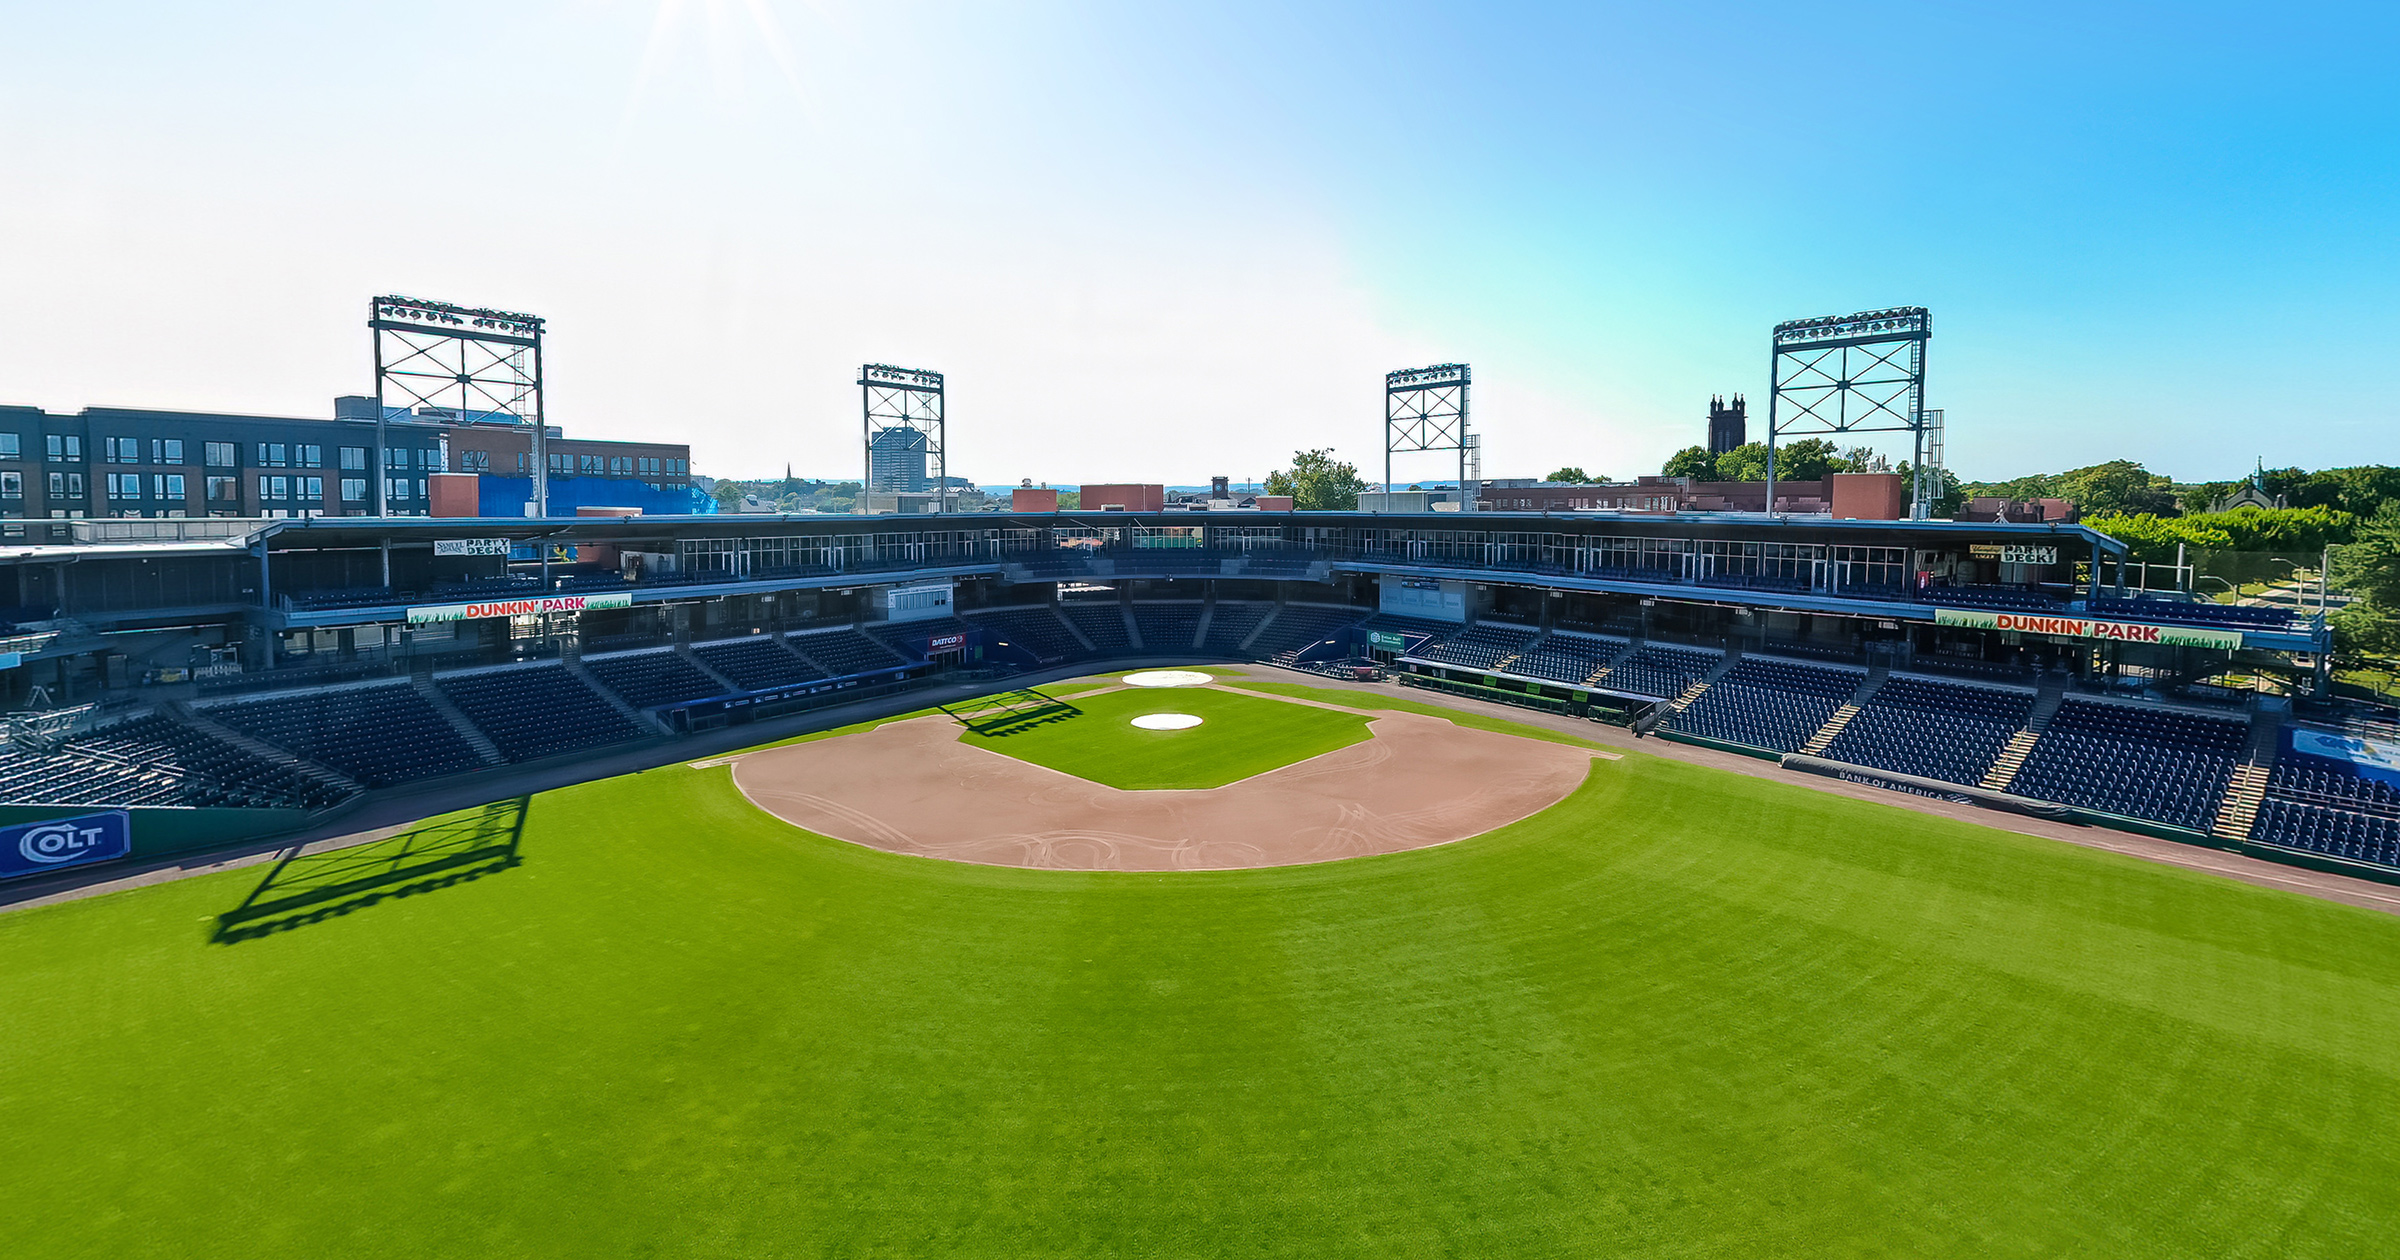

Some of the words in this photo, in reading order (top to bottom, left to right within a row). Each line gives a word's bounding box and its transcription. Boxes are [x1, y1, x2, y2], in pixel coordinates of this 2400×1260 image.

[467, 546, 508, 555] DECK!
[2004, 545, 2055, 554] PARTY
[2004, 553, 2054, 563] DECK!
[466, 601, 538, 618] DUNKIN'
[542, 597, 586, 612] PARK
[1997, 615, 2088, 635] DUNKIN'
[2094, 622, 2160, 642] PARK
[932, 636, 957, 647] DATTCO
[1839, 771, 1871, 785] BANK
[1872, 779, 1887, 788] OF
[1889, 784, 1943, 800] AMERICA
[19, 823, 103, 863] COLT
